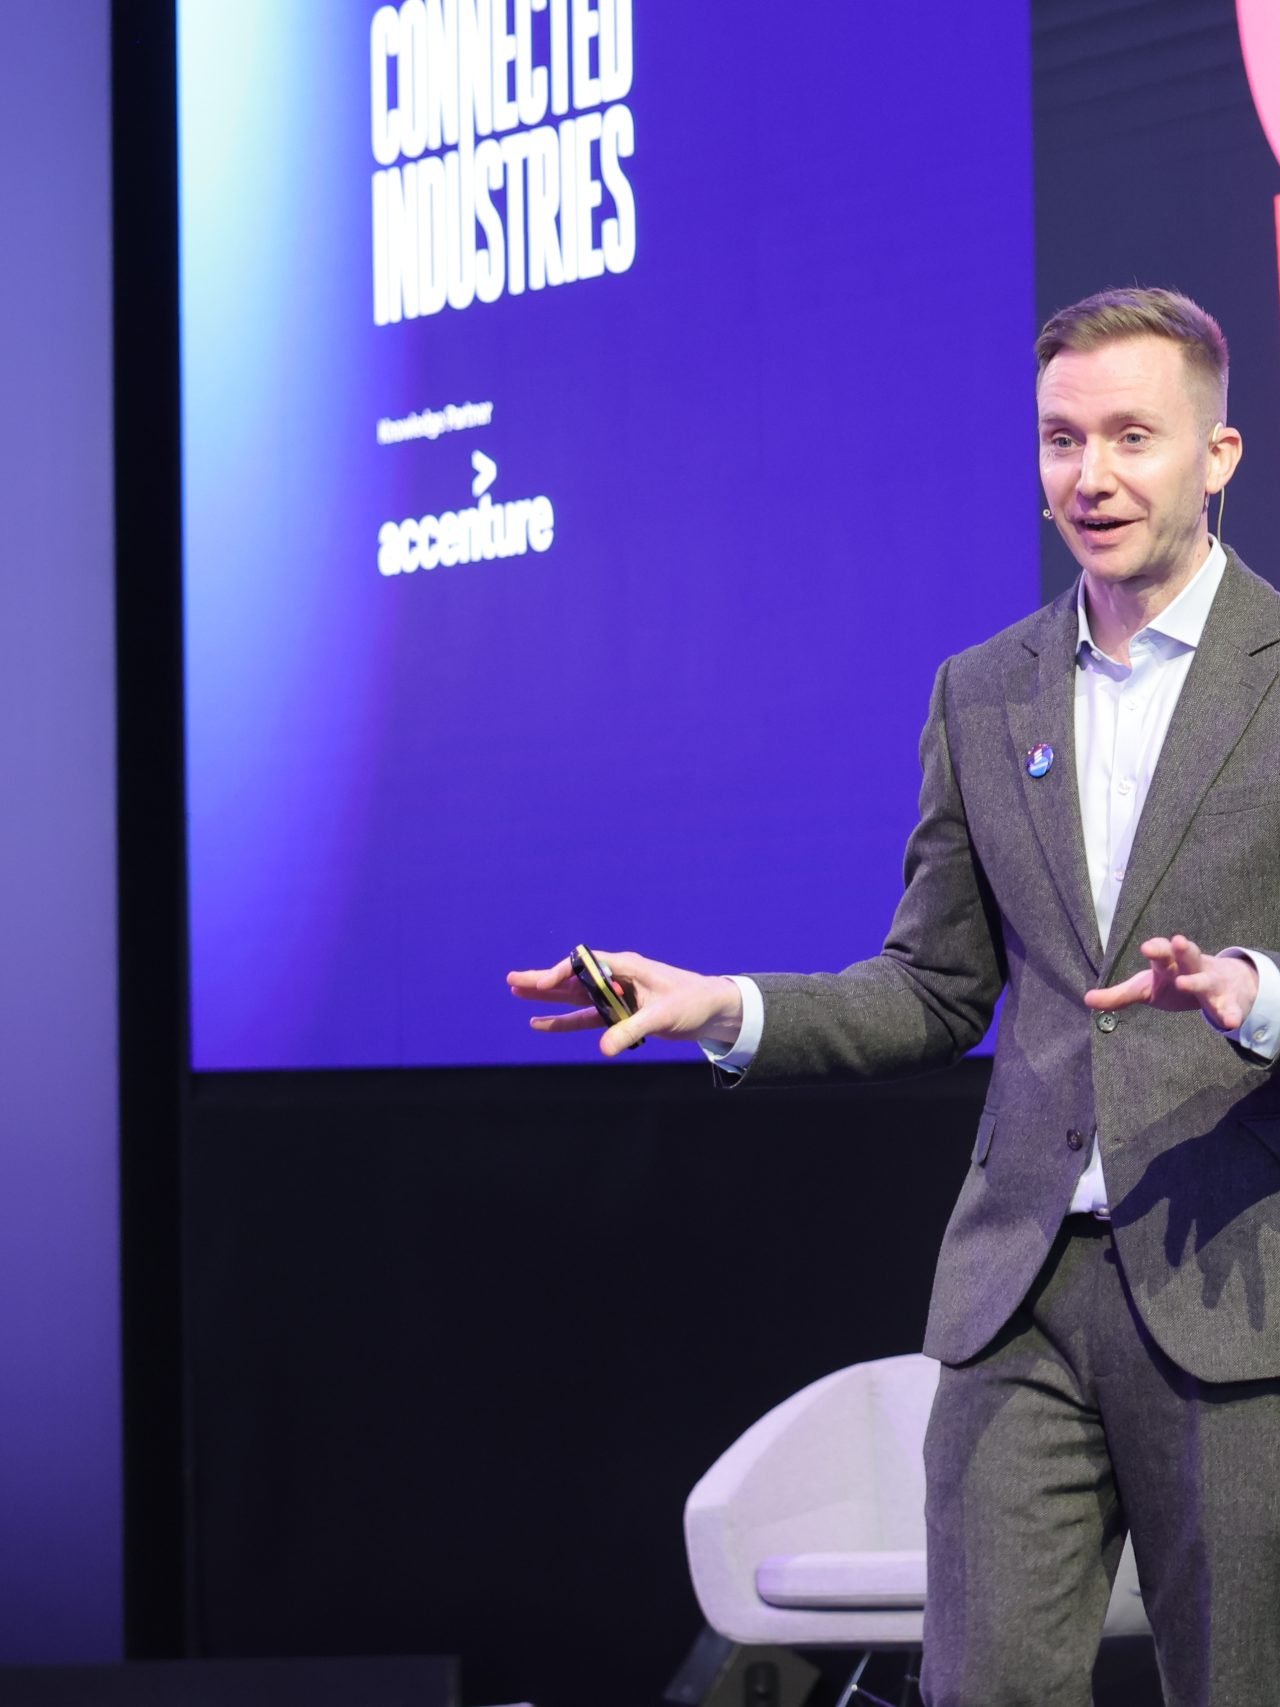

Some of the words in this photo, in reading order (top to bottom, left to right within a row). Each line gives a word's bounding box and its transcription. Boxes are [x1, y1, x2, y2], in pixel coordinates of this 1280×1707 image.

[370, 0, 633, 166] CONNECTED
[371, 103, 636, 327] INDUSTRIES
[378, 492, 554, 576] accenture
